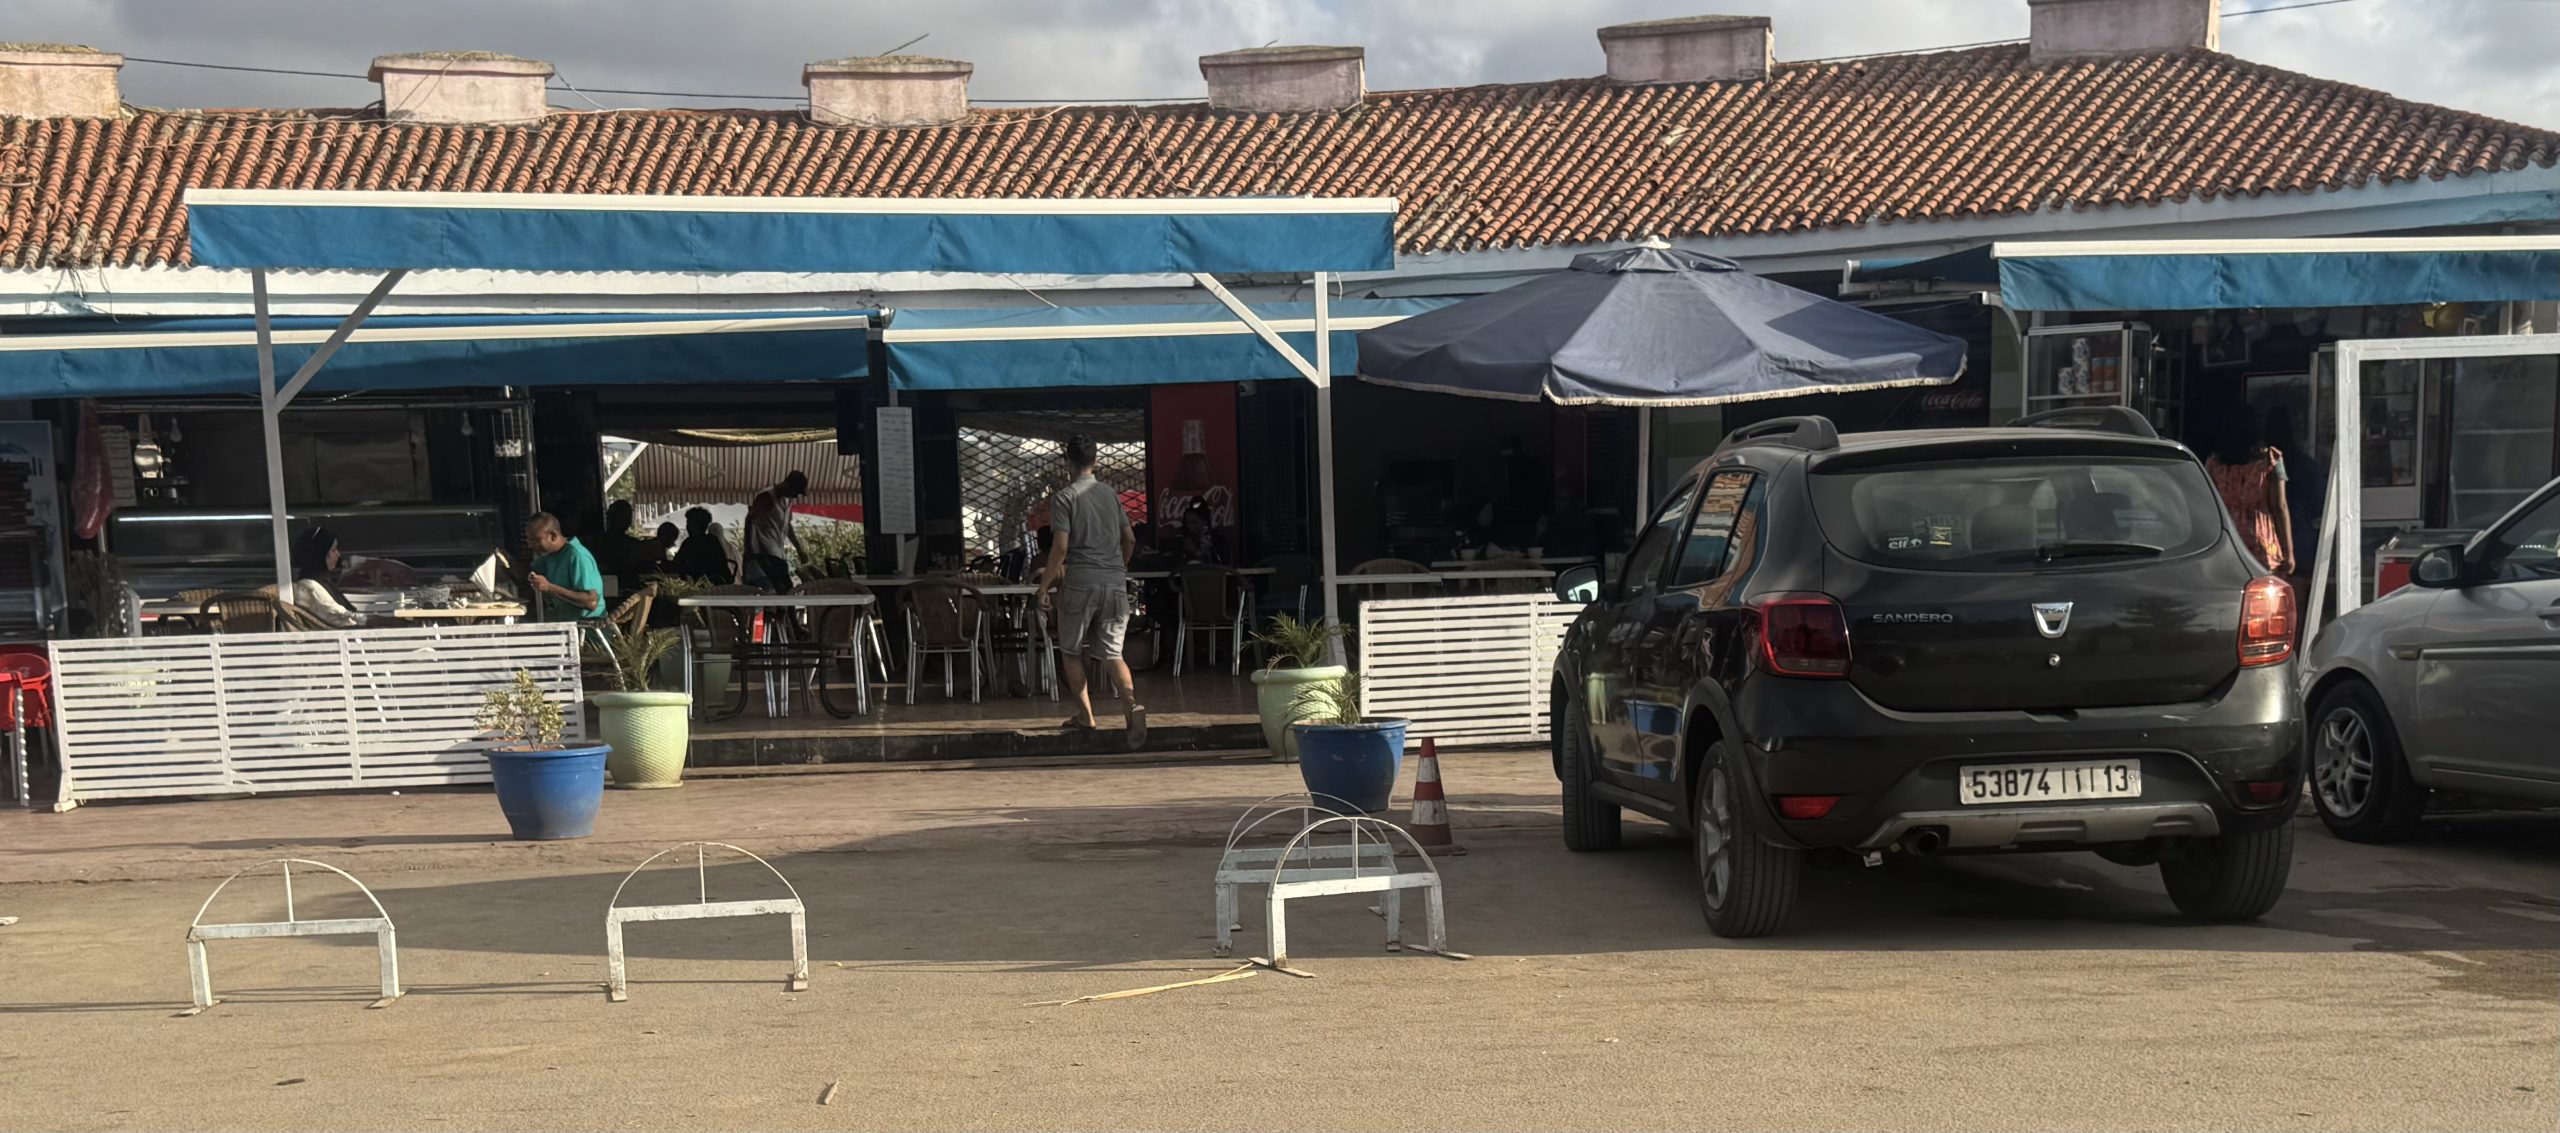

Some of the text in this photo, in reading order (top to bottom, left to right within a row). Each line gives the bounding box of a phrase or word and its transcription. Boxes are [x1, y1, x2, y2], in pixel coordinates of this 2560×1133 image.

[1157, 485, 1234, 529] CocaCol
[1872, 612, 1954, 624] SANDERO
[1972, 767, 2051, 798] 53874
[2103, 765, 2129, 792] 13
